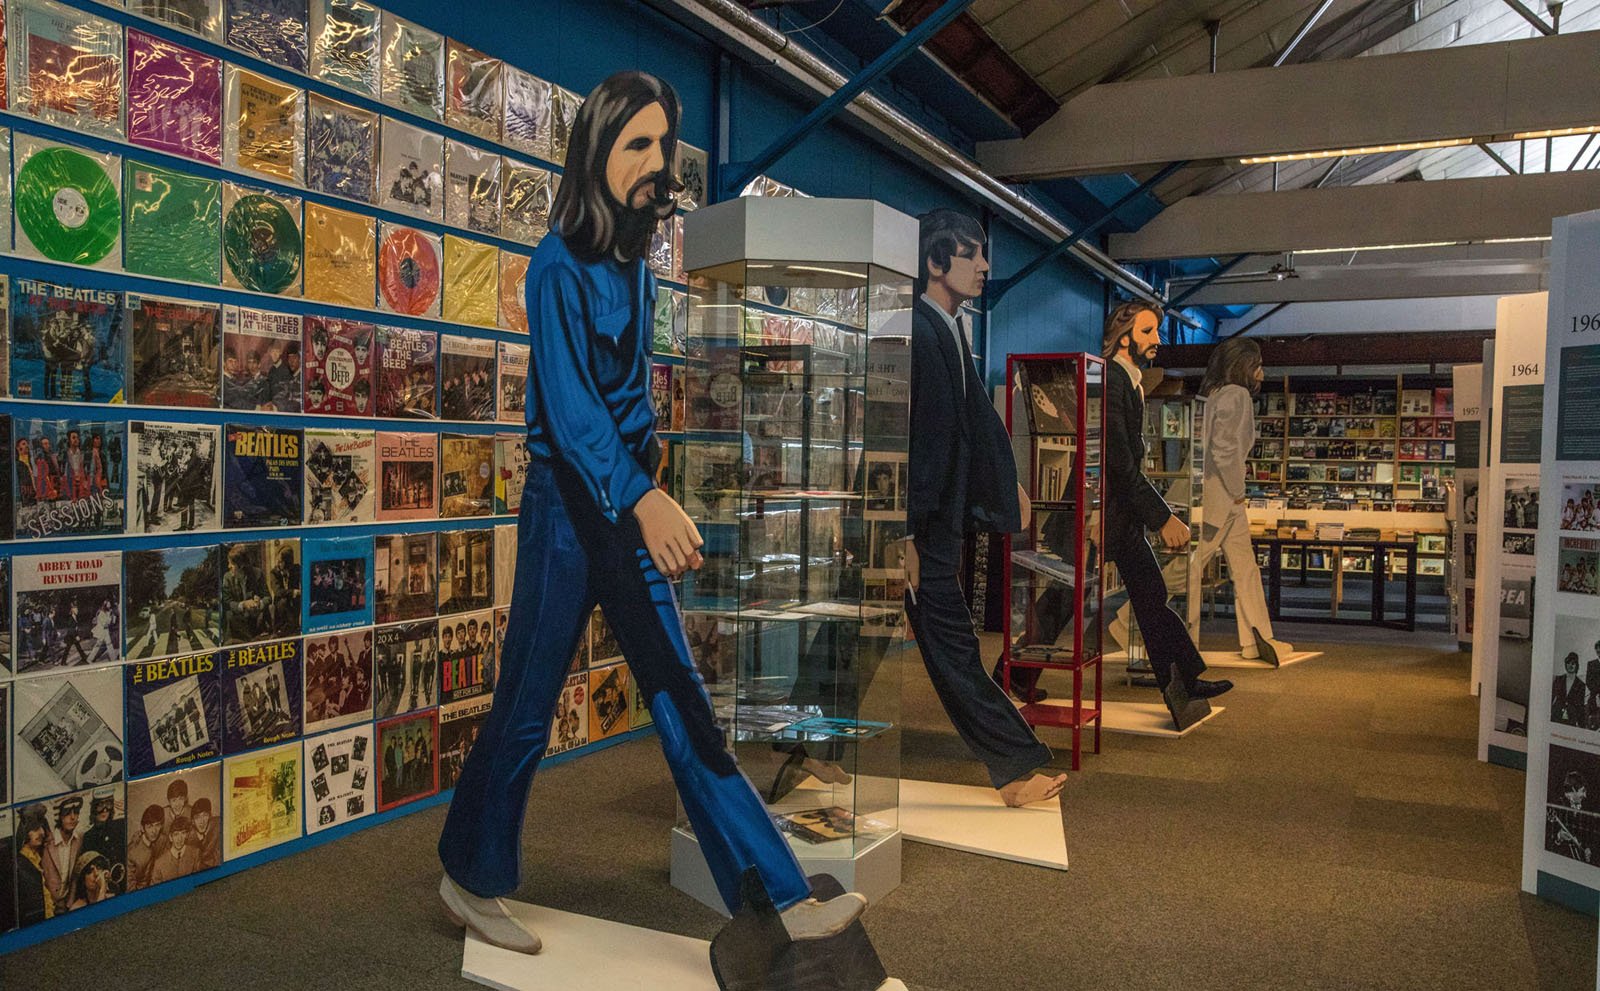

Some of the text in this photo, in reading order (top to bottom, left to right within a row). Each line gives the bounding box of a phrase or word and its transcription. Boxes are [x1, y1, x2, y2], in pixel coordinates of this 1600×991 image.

[17, 279, 47, 296] THE
[54, 285, 116, 305] BEATLES
[241, 310, 259, 321] THE
[261, 313, 299, 327] BEATLES
[243, 320, 254, 329] AT
[256, 321, 273, 332] THE
[276, 325, 299, 335] BEEB
[406, 331, 421, 341] THE
[390, 339, 428, 353] BEATLES
[383, 349, 412, 360] AT THE
[383, 358, 407, 370] BEEB
[1512, 363, 1539, 377] 1964
[652, 369, 668, 385] tles
[1462, 407, 1480, 416] 1957
[235, 431, 299, 458] BEATLES
[399, 436, 420, 447] THE
[381, 446, 434, 458] BEATLES
[28, 488, 114, 539] SESSIONS
[37, 559, 103, 572] ABBEY ROAD
[43, 572, 98, 585] REVISITED
[377, 635, 387, 644] 20
[238, 641, 296, 668] BEATLES
[146, 655, 214, 682] BEATLES
[442, 703, 491, 721] THE BEATLES
